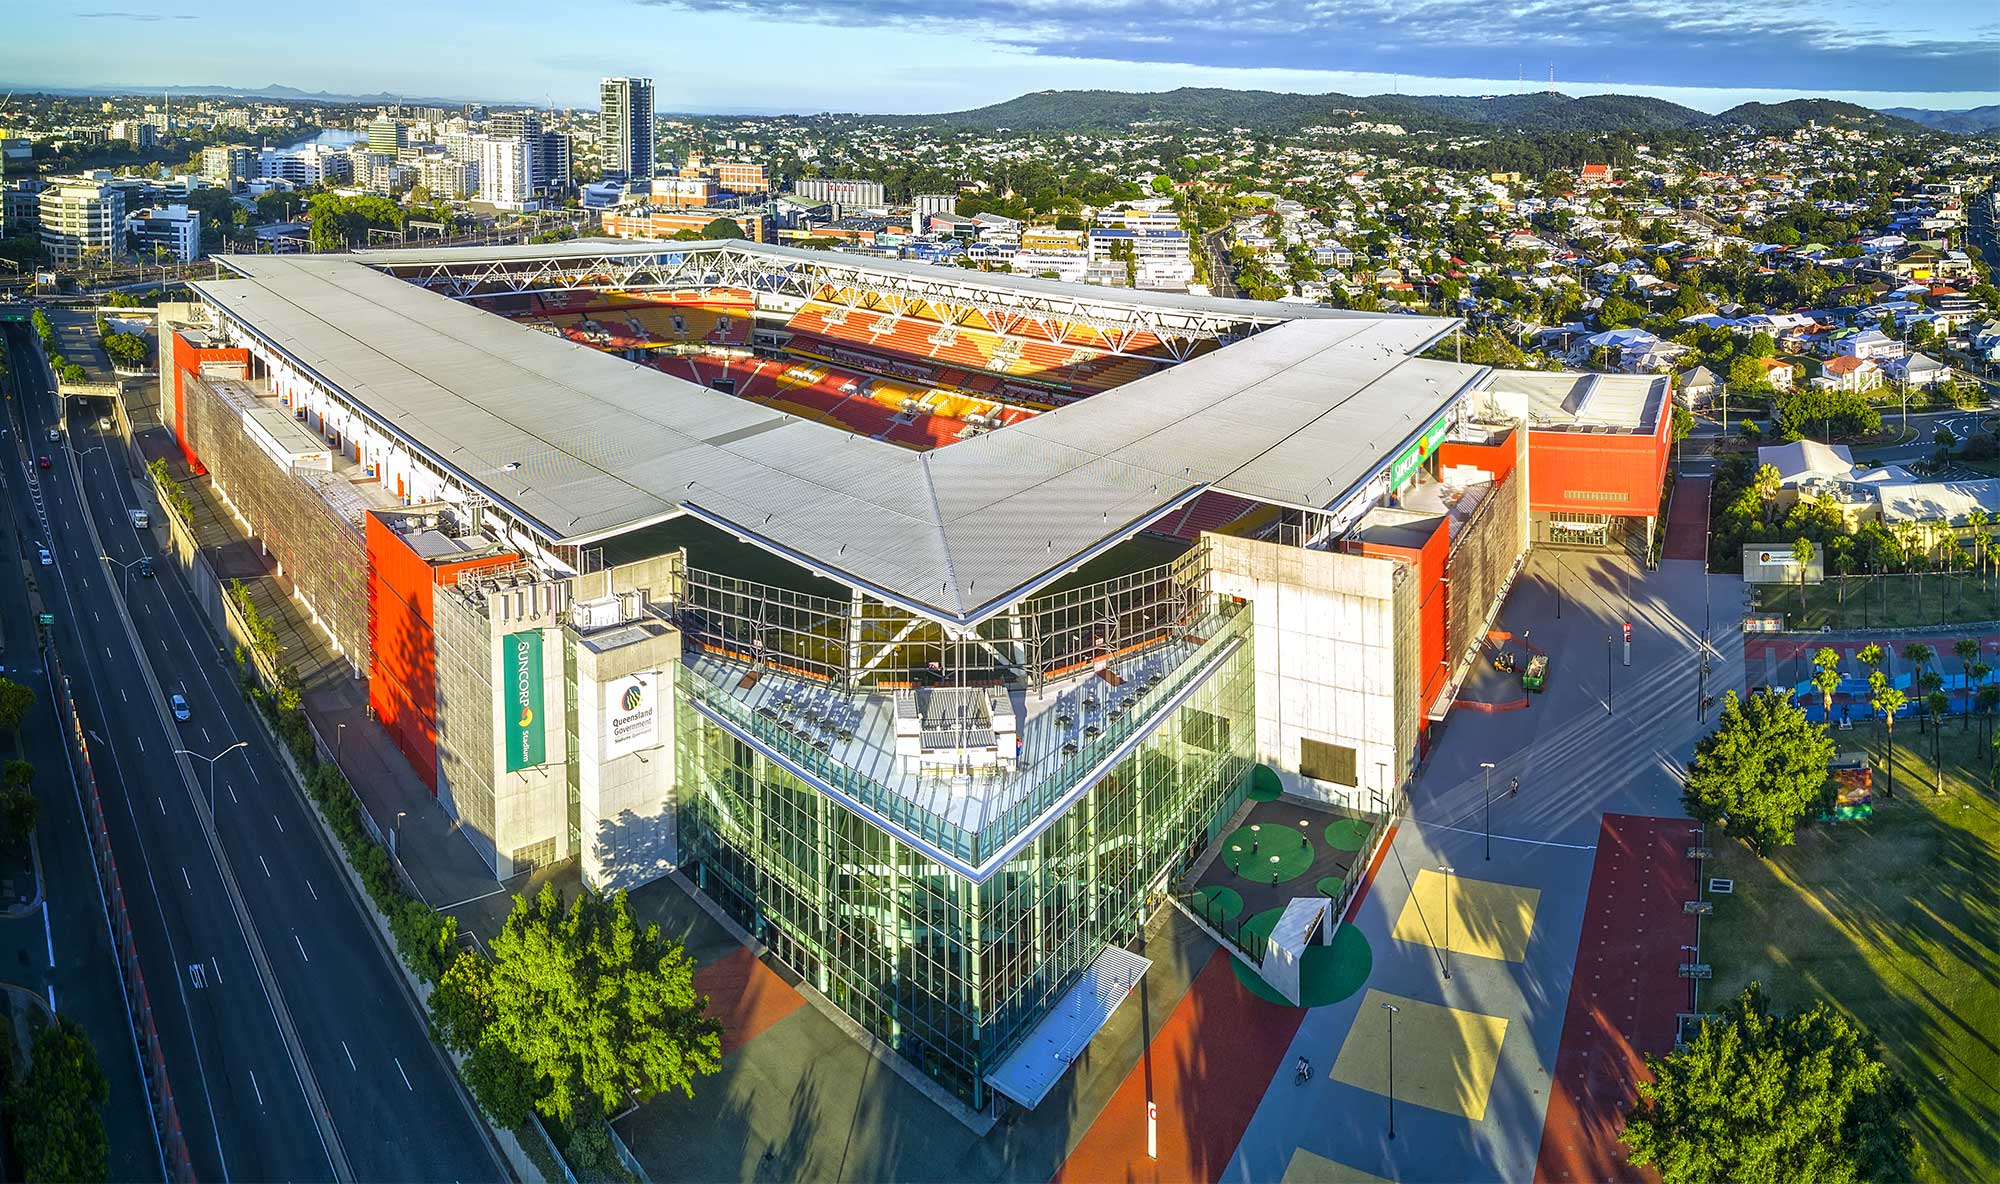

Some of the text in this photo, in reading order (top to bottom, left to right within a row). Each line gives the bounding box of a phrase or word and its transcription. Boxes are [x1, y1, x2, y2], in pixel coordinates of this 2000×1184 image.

[518, 641, 530, 707] SUNCORP
[612, 707, 653, 727] Queensland
[613, 718, 652, 736] Government
